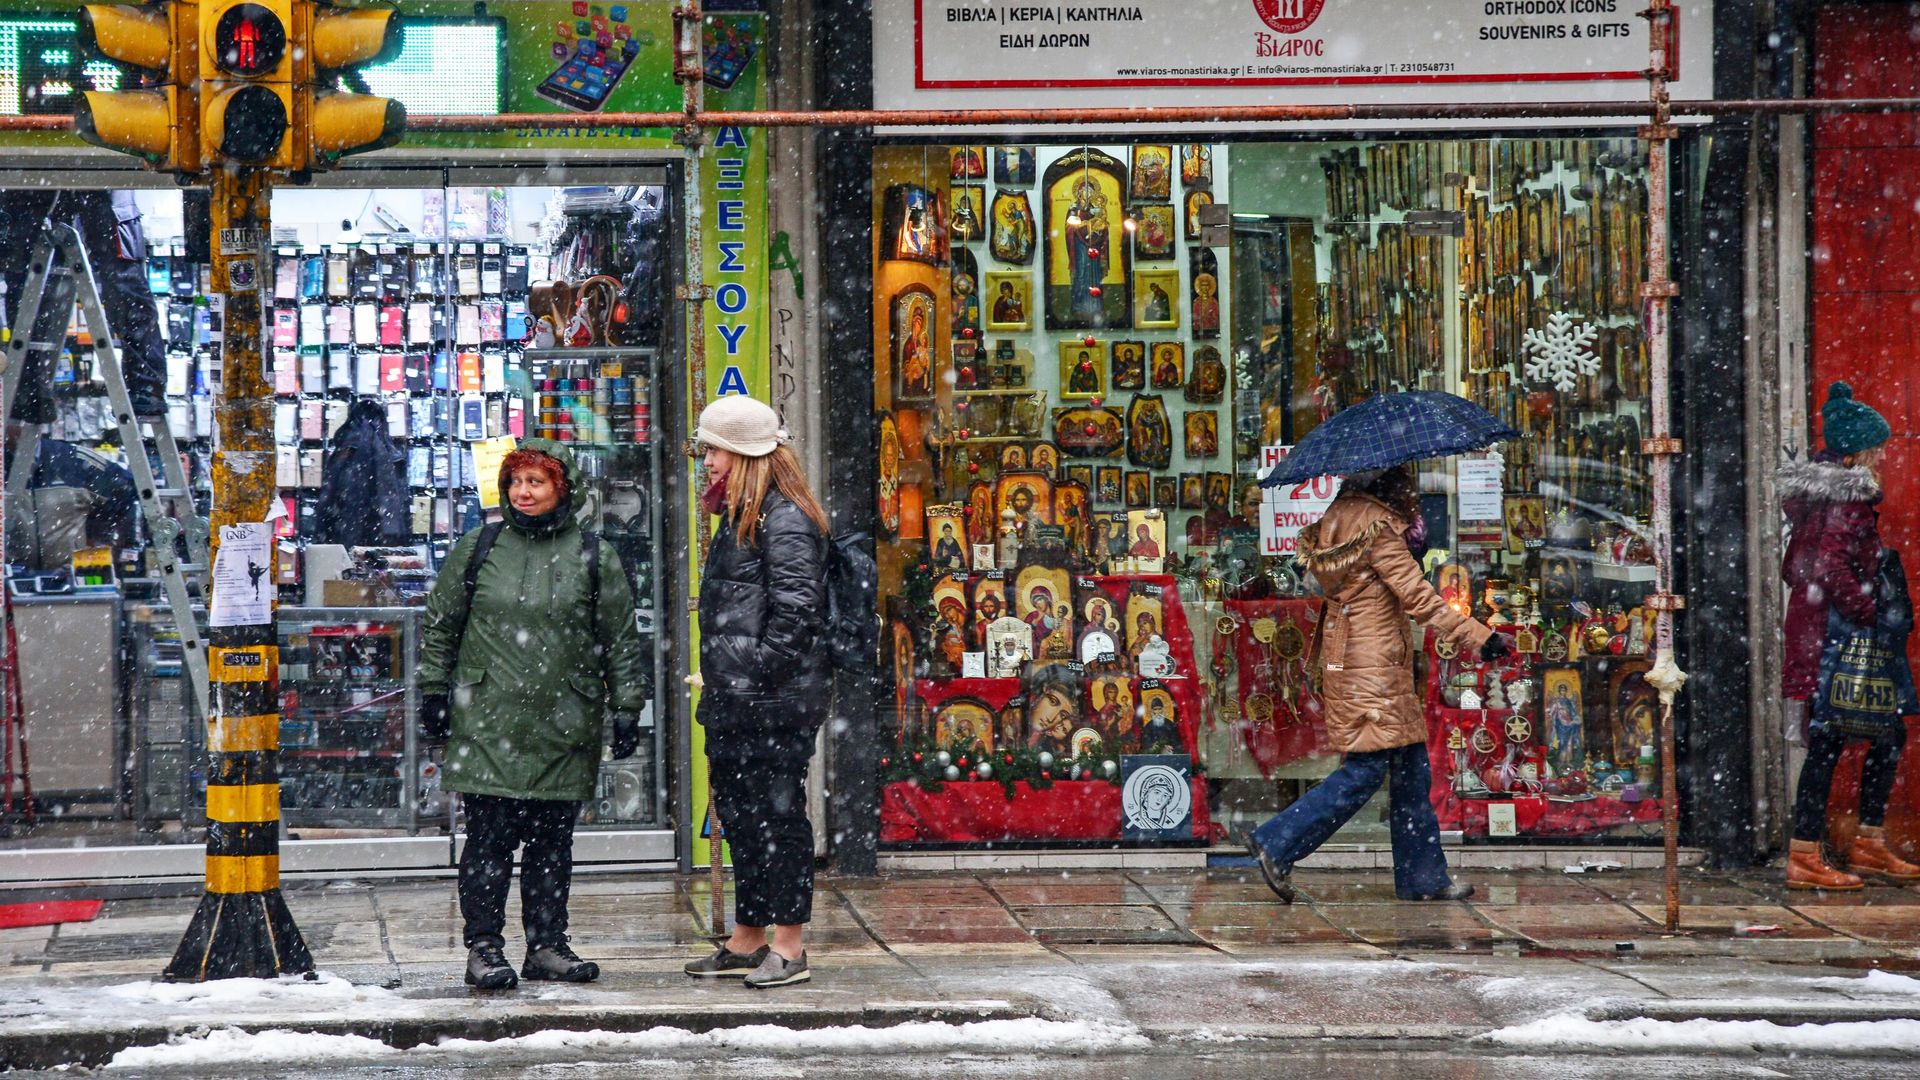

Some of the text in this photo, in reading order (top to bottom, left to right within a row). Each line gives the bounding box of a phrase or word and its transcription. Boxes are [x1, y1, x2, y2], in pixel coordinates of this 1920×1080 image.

[946, 7, 1143, 22] ΒΙΒΛΙΑ ΚΕΡΙΑ ΚΑΝΤΗΛΙΑ
[1484, 0, 1617, 15] ORTHODOX ICONS
[1479, 23, 1630, 40] SOUVENIRS & GIFTS
[999, 33, 1090, 48] ΕΙΔΗ ΔΩΡΩΝ
[1116, 66, 1240, 76] www.viaros-monastiriaka.gr
[1257, 65, 1383, 75] info@viaros-monastiriaka.gr
[1400, 63, 1455, 72] 2310548731
[714, 126, 749, 397] ΑΞΕΣΟΥΑ
